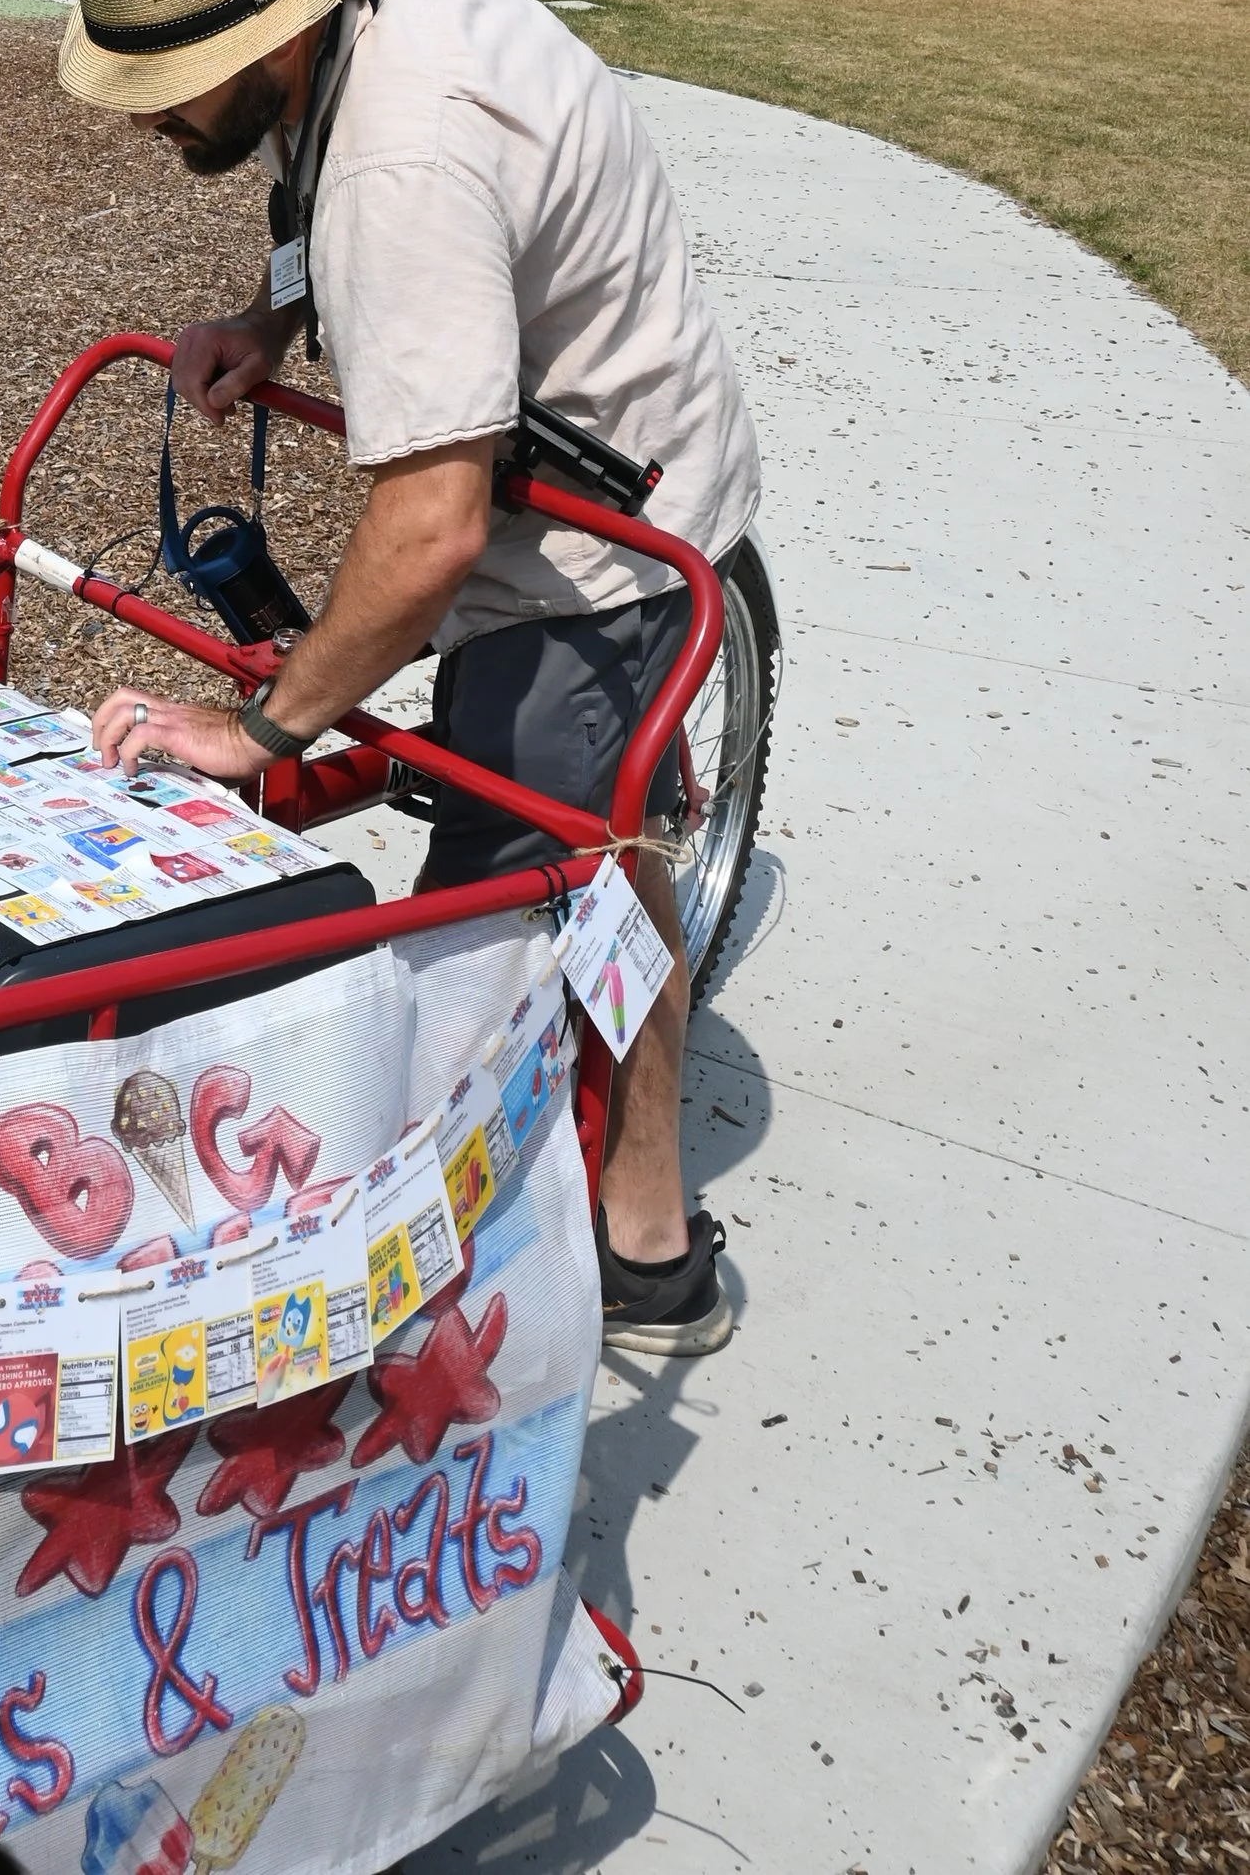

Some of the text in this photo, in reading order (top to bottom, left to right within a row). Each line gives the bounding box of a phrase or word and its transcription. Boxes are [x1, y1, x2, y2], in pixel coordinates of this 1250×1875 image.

[350, 1286, 366, 1295] Facts
[206, 1317, 236, 1333] Nutrition
[5, 1363, 24, 1371] YUMMY
[61, 1359, 114, 1371] Nutrition Facts
[25, 1368, 48, 1377] TREAT.
[14, 1378, 54, 1388] APPROVED.
[59, 1390, 81, 1399] Calories
[132, 1546, 235, 1761] &
[243, 1429, 544, 1699] Treats
